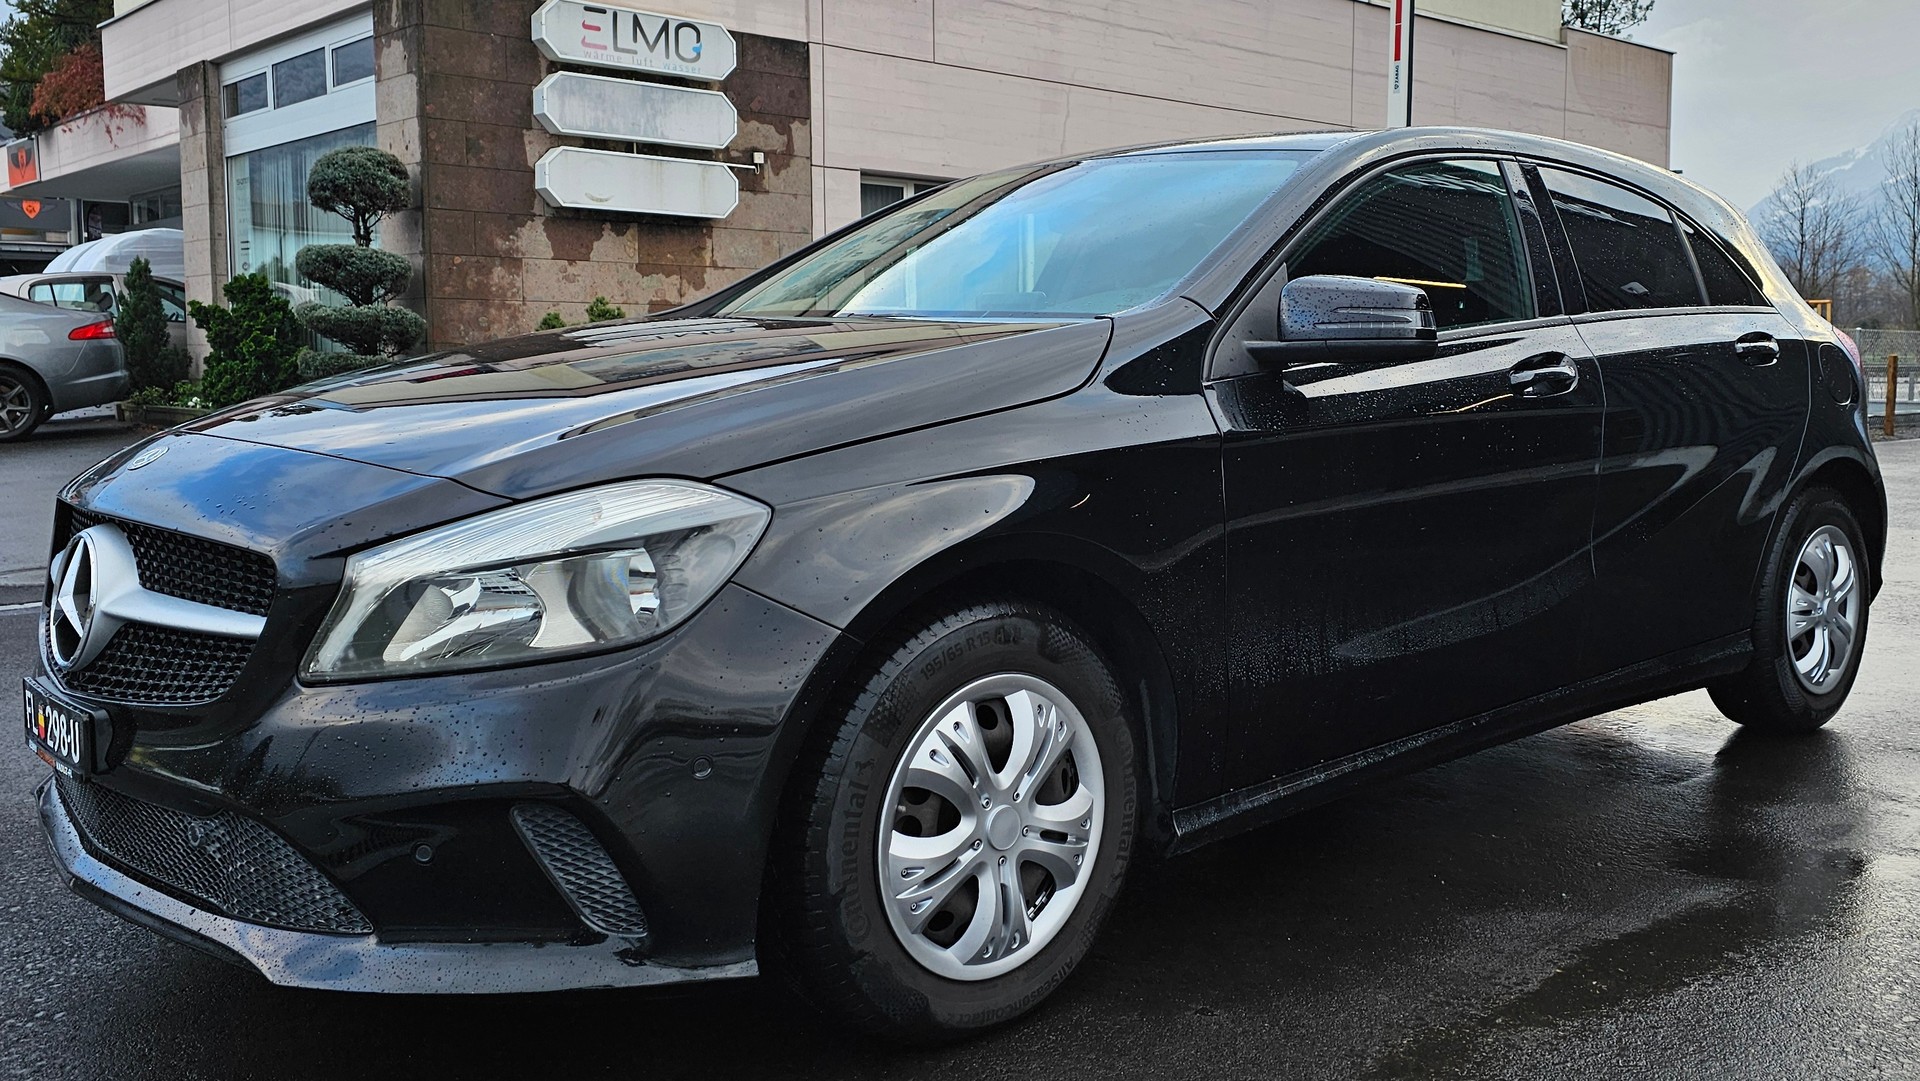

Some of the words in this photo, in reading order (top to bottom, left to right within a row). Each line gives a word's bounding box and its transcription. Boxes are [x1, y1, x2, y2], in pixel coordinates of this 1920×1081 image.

[581, 5, 702, 63] ELMO
[583, 50, 622, 64] wärme
[631, 56, 653, 68] luft
[663, 62, 701, 74] wasser
[920, 642, 964, 681] 195/65
[25, 689, 39, 736] FL
